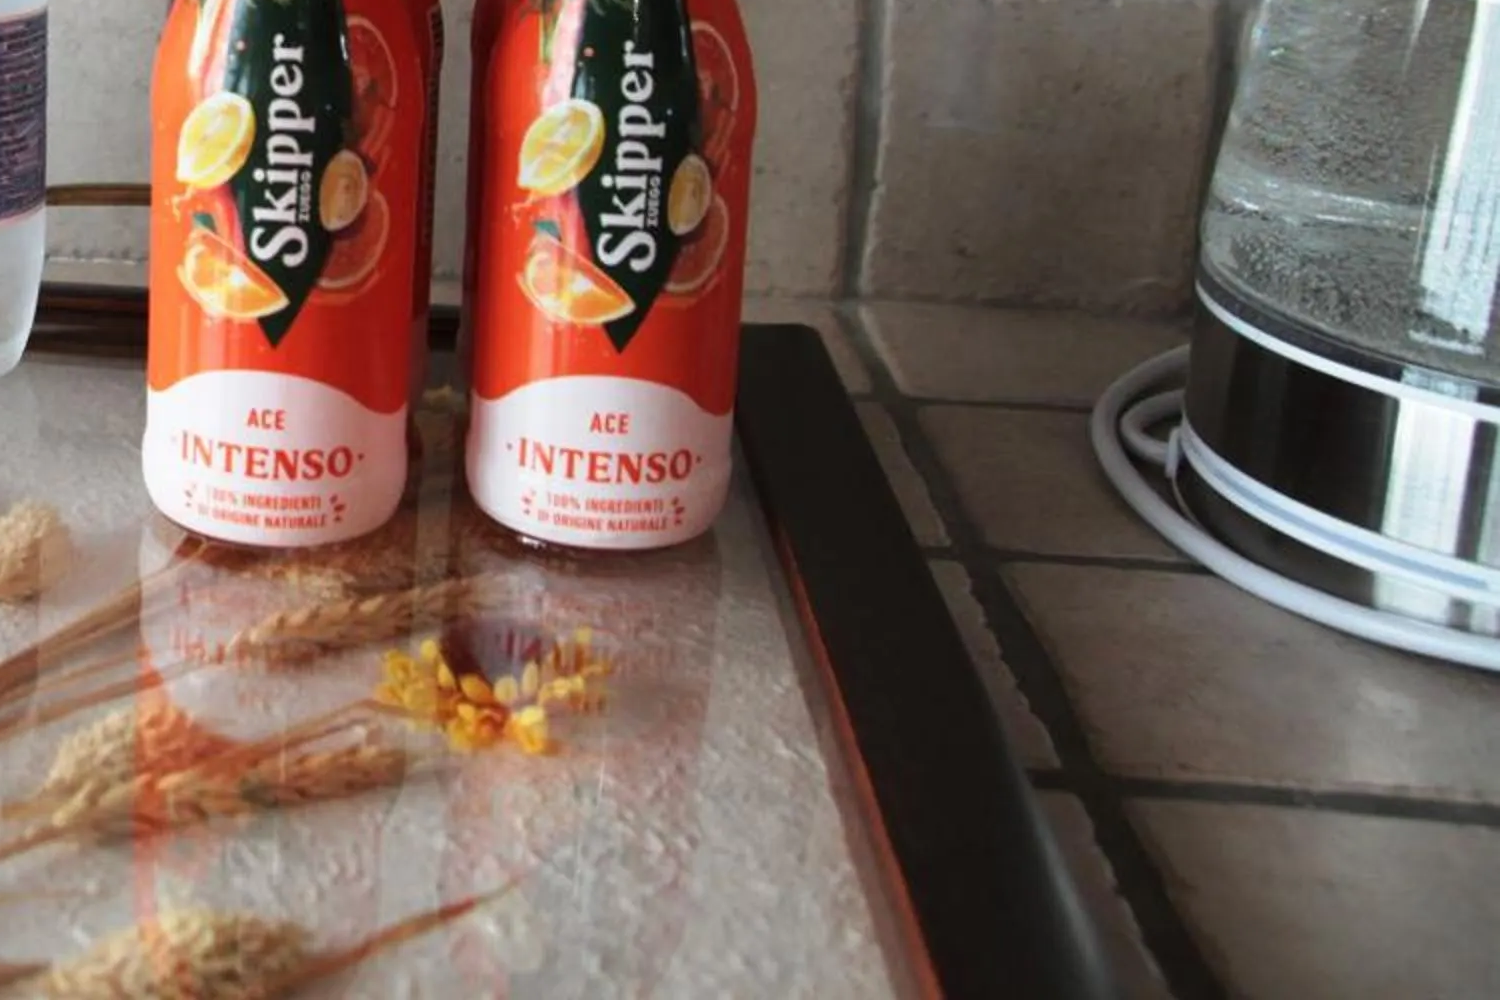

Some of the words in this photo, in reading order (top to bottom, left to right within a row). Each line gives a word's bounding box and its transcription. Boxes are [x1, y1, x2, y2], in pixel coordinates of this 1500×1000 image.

[250, 33, 315, 268] Skipper
[597, 40, 666, 273] Skipper
[246, 408, 286, 430] ACE
[590, 413, 630, 434] ACE
[181, 430, 354, 481] INTENSO
[518, 437, 693, 485] INTENSO
[243, 493, 322, 511] INGREDIENTI
[585, 497, 664, 514] INGREDIENTI
[606, 516, 667, 532] NATURALE
